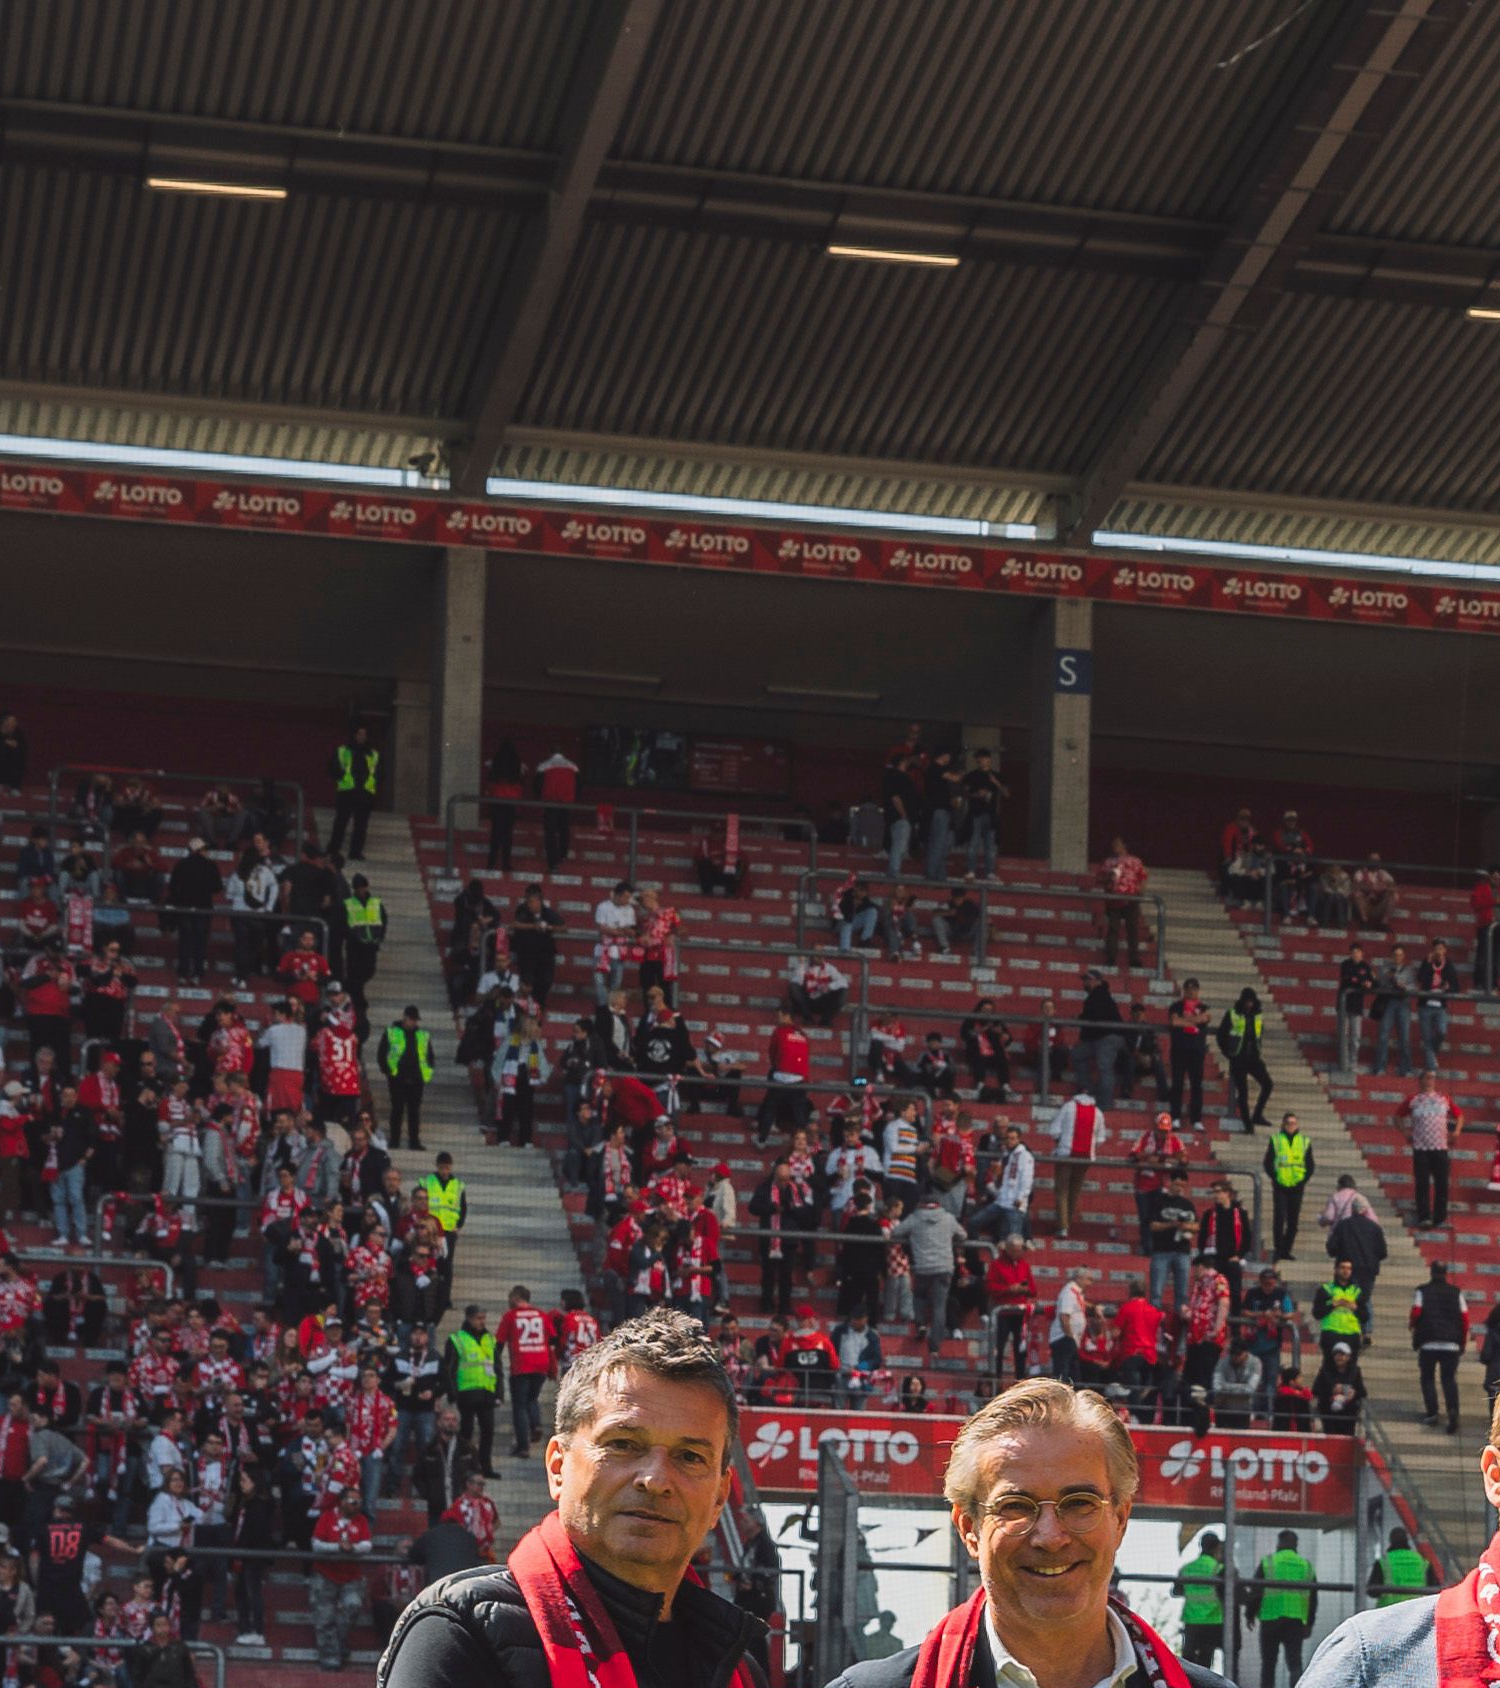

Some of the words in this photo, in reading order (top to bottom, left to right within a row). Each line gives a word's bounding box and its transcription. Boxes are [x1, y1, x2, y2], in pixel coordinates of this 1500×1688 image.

[1, 474, 64, 495] LOTTO
[120, 484, 182, 506] LOTTO
[238, 494, 300, 515] LOTTO
[355, 504, 417, 525] LOTTO
[471, 514, 532, 535] LOTTO
[586, 523, 646, 545] LOTTO
[690, 533, 749, 554] LOTTO
[802, 543, 861, 564] LOTTO
[914, 552, 972, 573] LOTTO
[1025, 561, 1083, 582] LOTTO
[1137, 570, 1195, 591] LOTTO
[1245, 580, 1301, 601] LOTTO
[1352, 590, 1408, 610] LOTTO
[1058, 655, 1078, 686] S
[516, 1317, 544, 1344] 29
[800, 1427, 919, 1465] LOTTO
[1211, 1446, 1329, 1484] LOTTO
